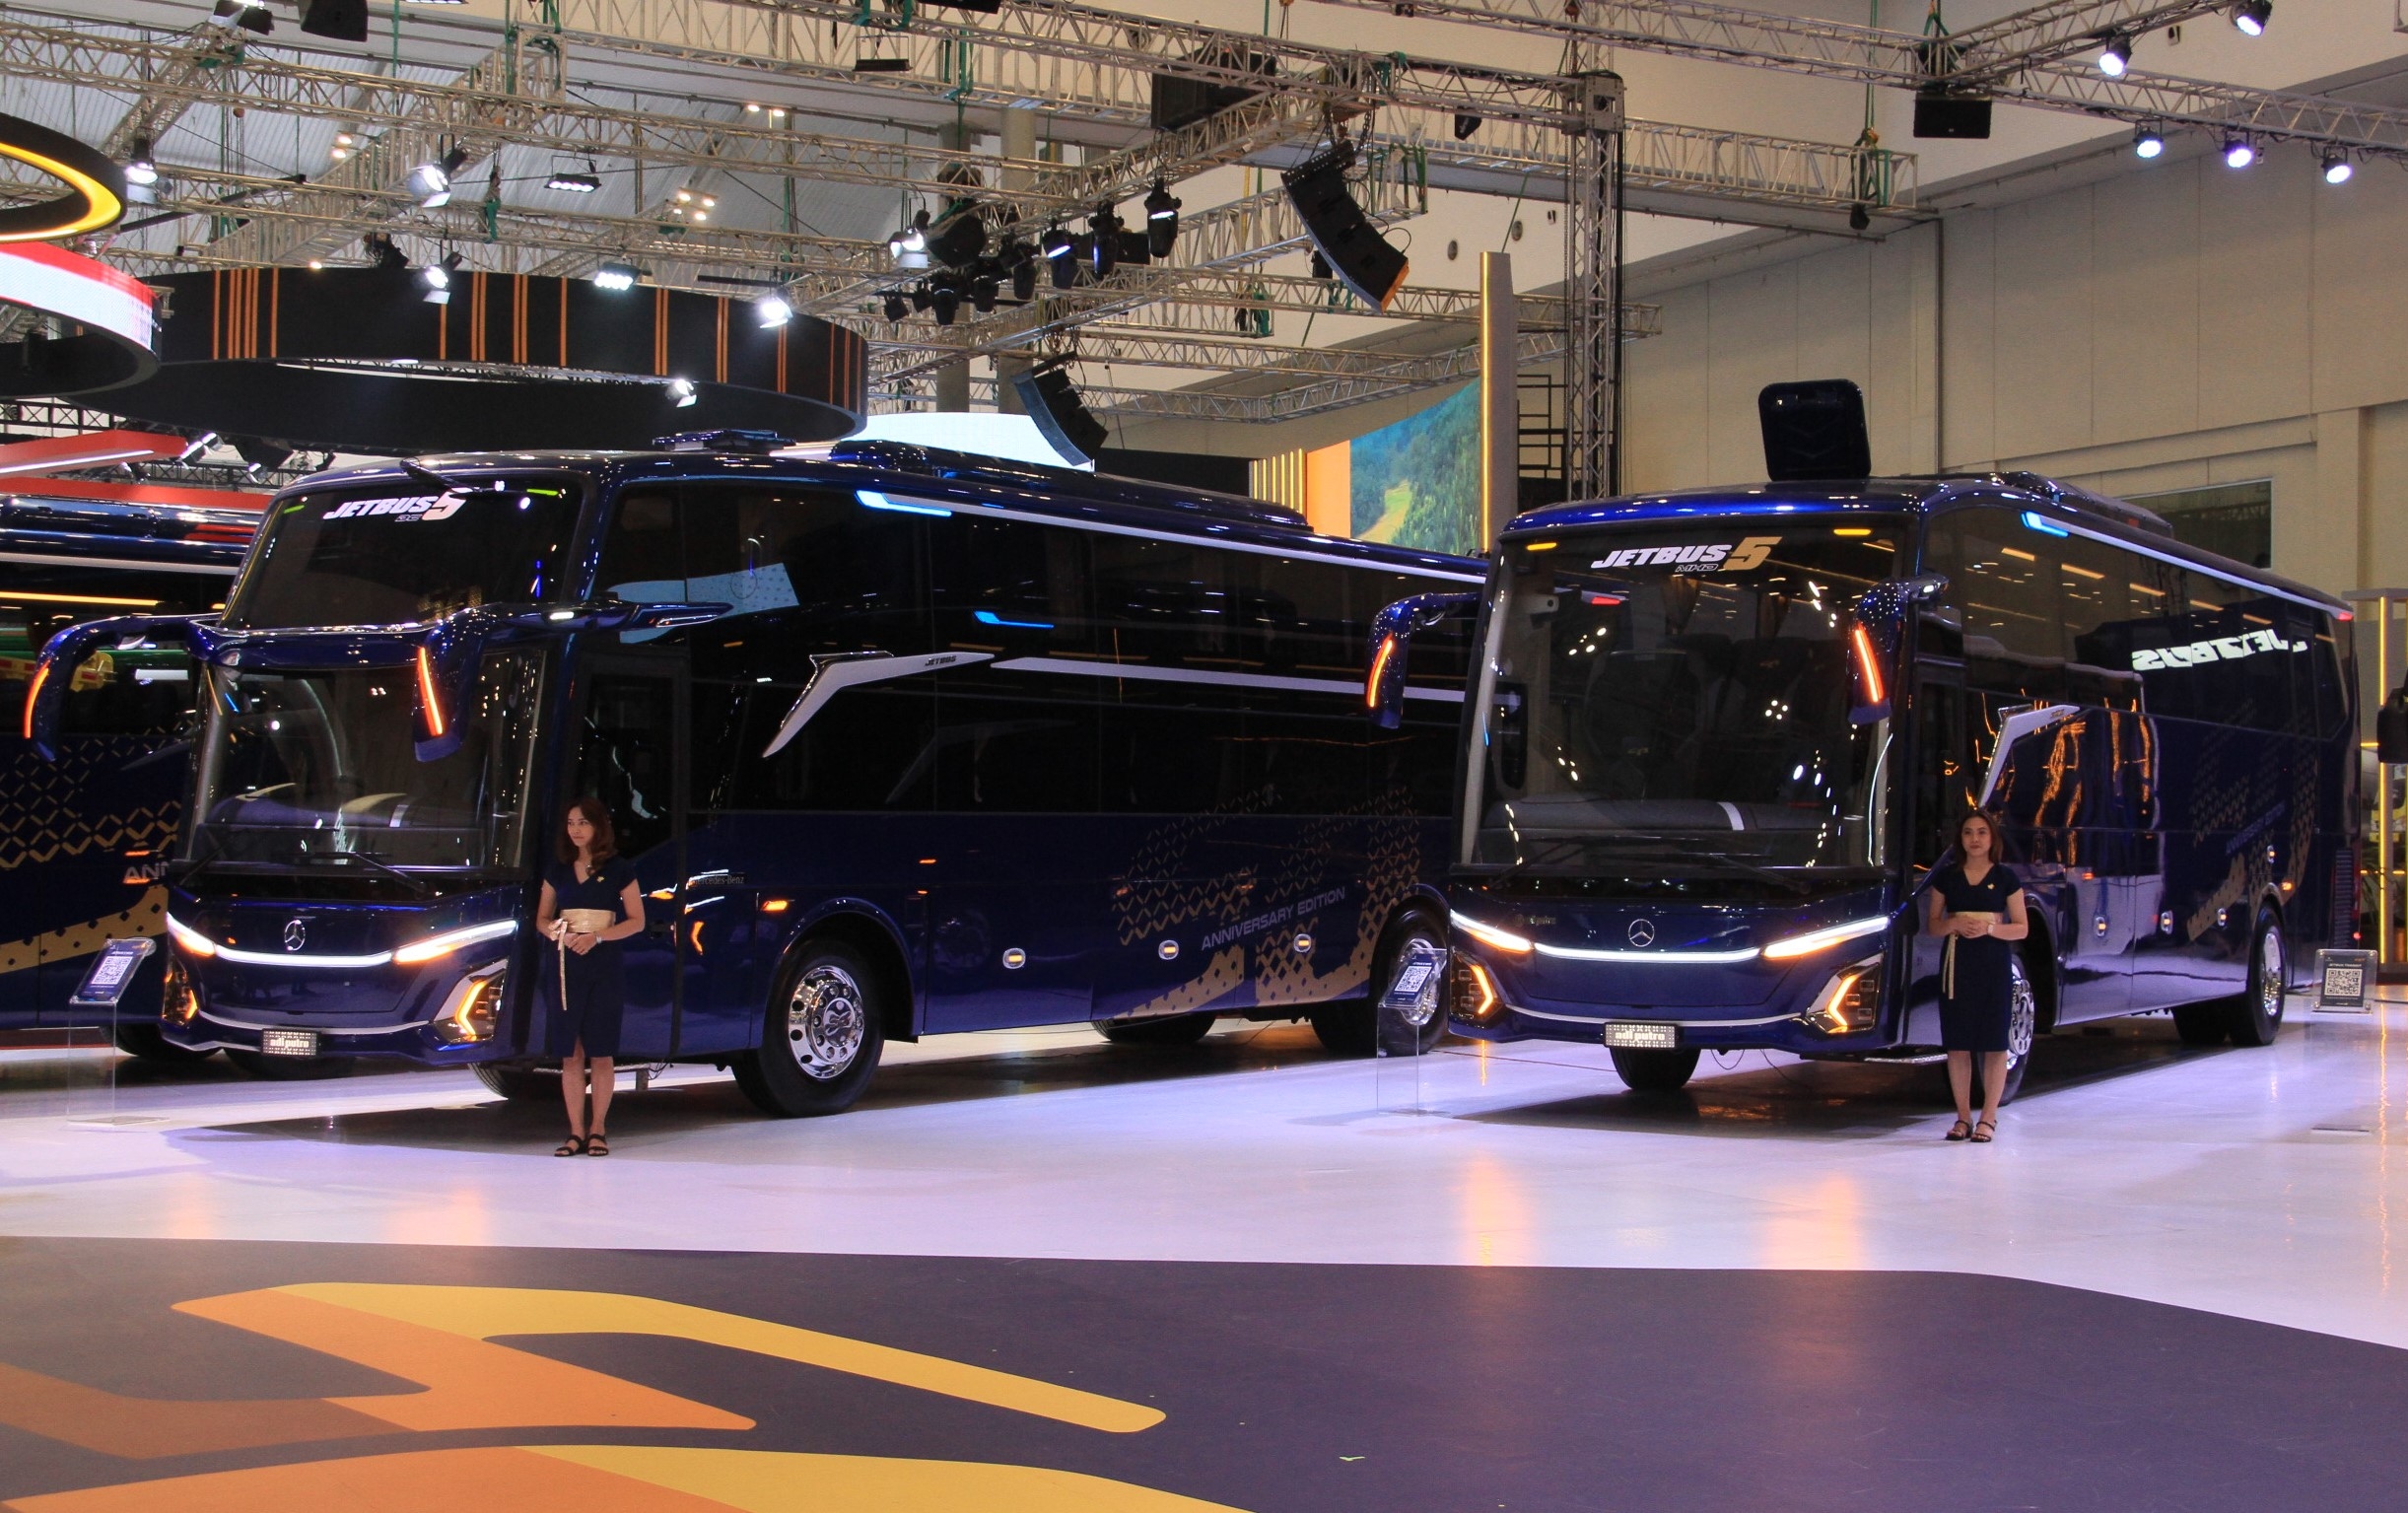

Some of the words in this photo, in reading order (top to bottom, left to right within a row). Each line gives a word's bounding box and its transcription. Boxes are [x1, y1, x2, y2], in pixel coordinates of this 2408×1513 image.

[322, 496, 440, 520] JETBUS
[1590, 544, 1733, 569] JETBUS
[1722, 536, 1783, 571] 5
[1201, 904, 1294, 952] ANNIVERSARY
[1297, 886, 1346, 916] EDITION
